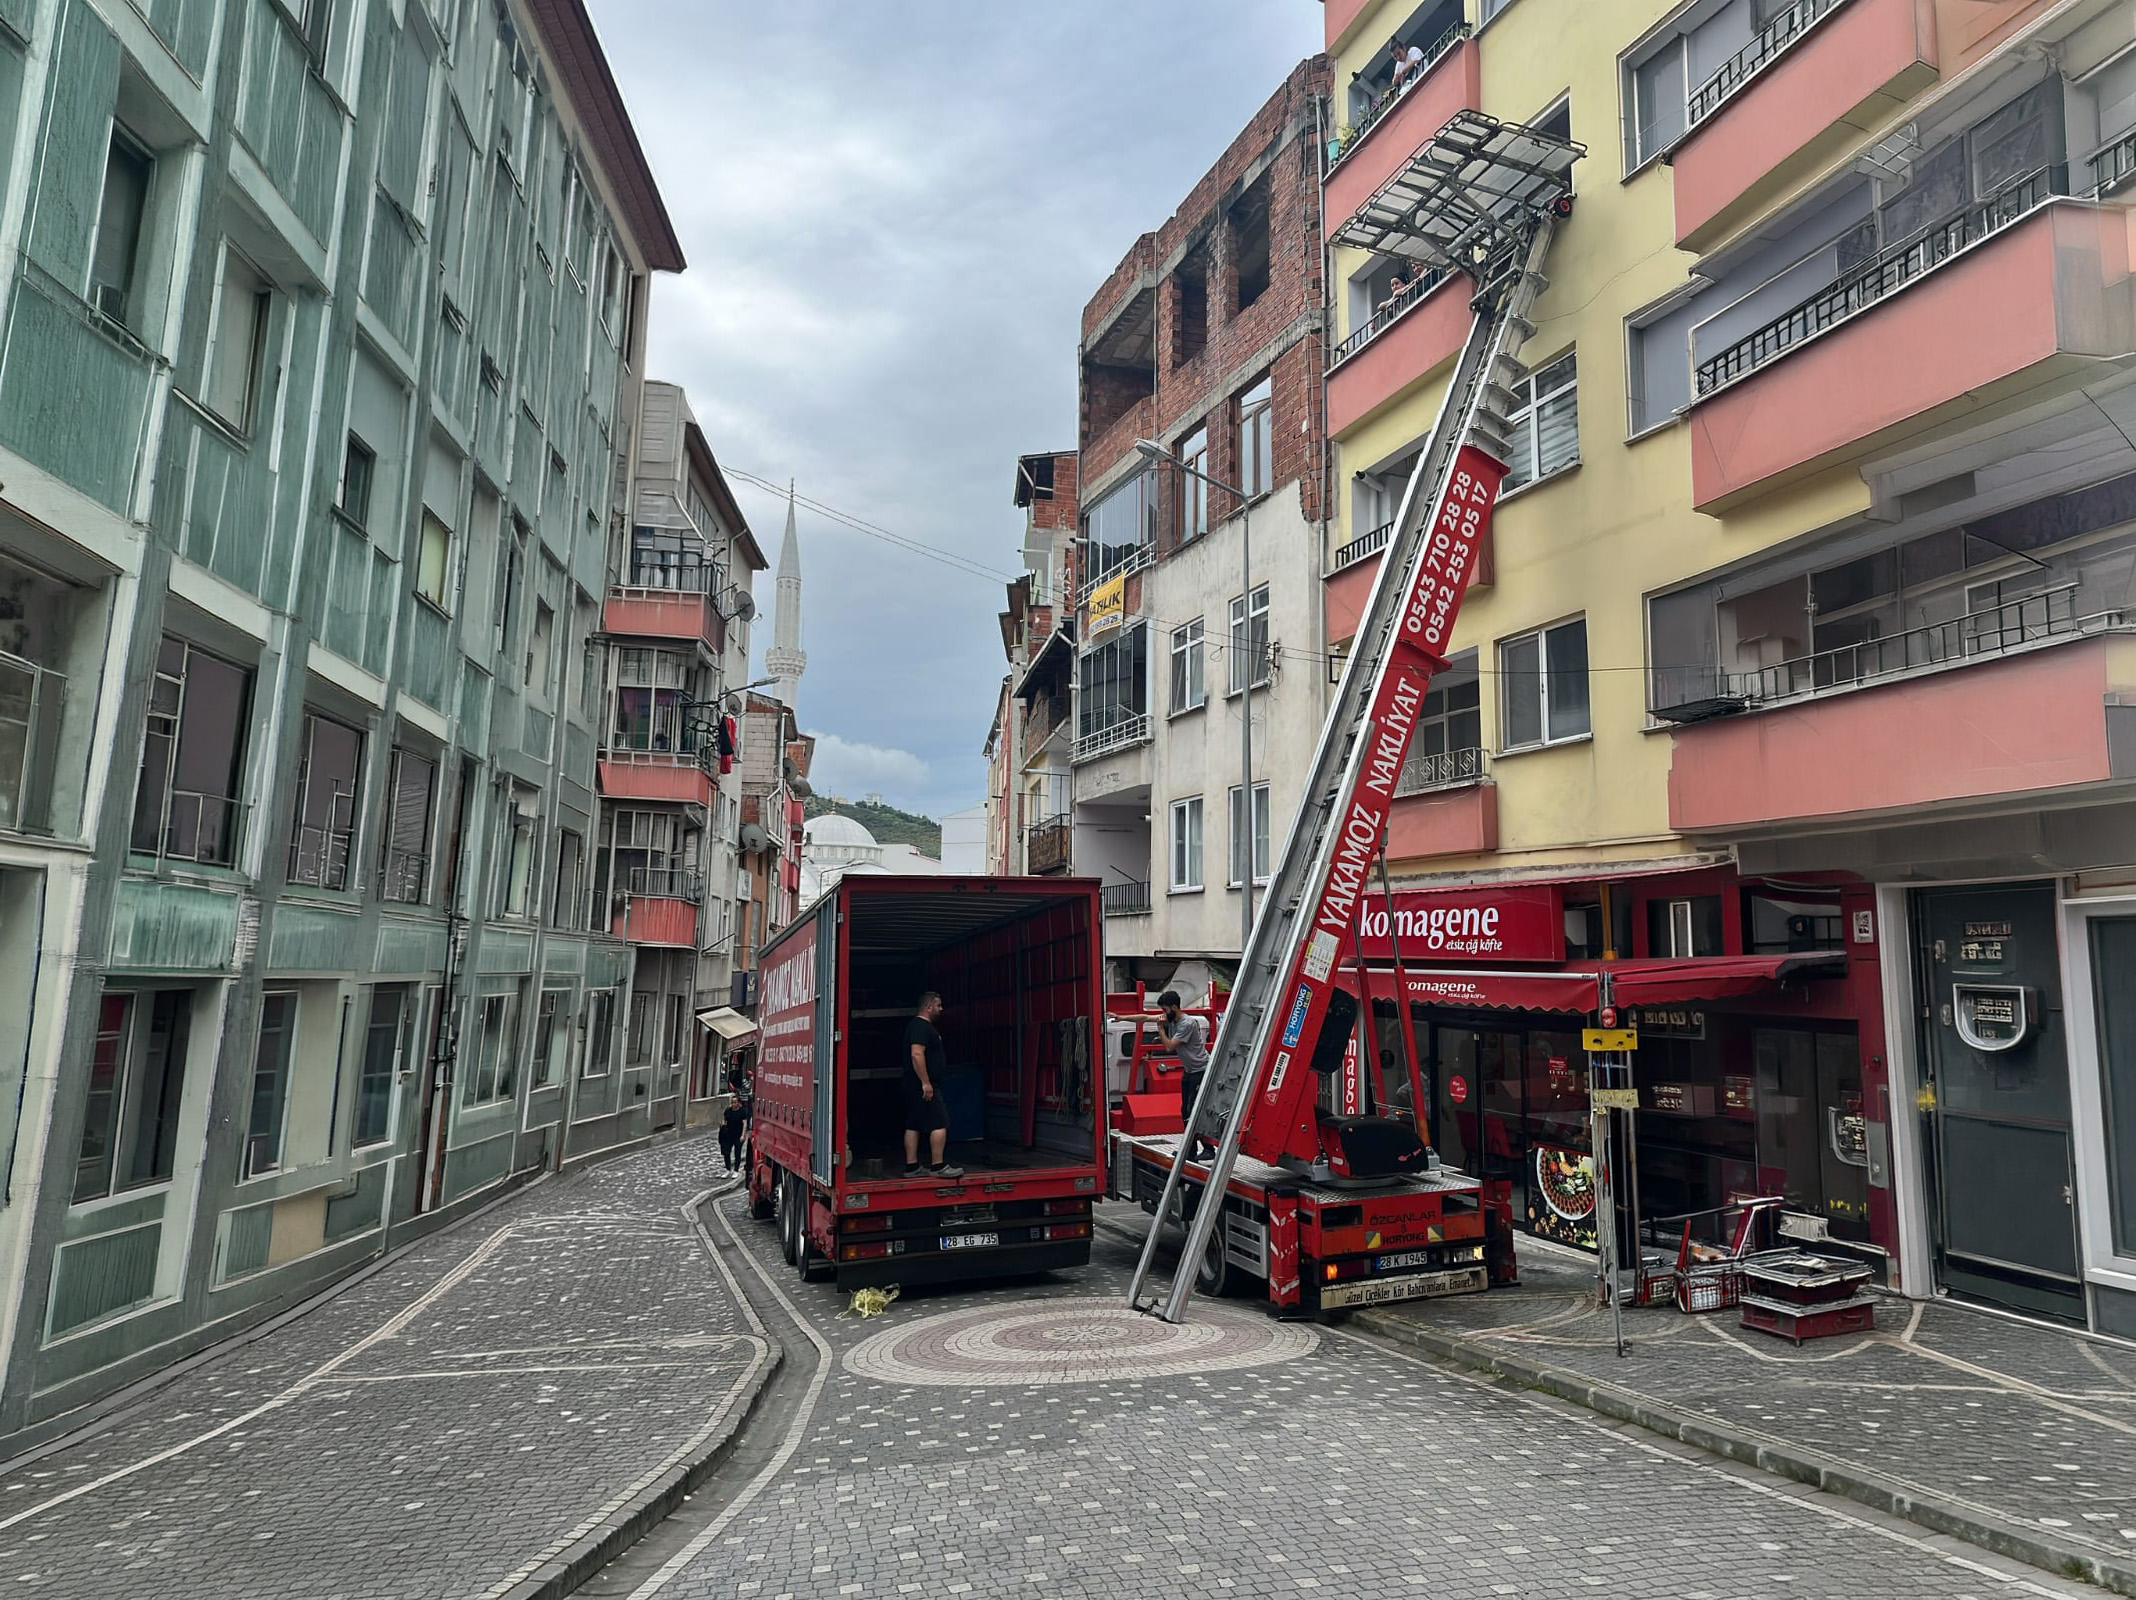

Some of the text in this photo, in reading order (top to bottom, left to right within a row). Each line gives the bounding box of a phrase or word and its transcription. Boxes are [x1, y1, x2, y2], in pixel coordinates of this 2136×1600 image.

[1406, 471, 1471, 633] 0543 710 28 28
[1425, 480, 1488, 644] 0542 253 05 17
[1319, 802, 1382, 929] YAKAMOZ
[1366, 677, 1420, 796] NAKLİYAT
[1360, 900, 1499, 949] komagene
[1446, 938, 1503, 954] etsiz çiğ köfte
[1406, 981, 1476, 995] omagene
[1289, 989, 1307, 1029] HORYONG
[1370, 1210, 1436, 1226] ÖZCANLAR
[947, 1234, 996, 1247] 28 EG 735
[1382, 1233, 1424, 1246] HORYONG
[1381, 1252, 1426, 1268] 28 K 1945
